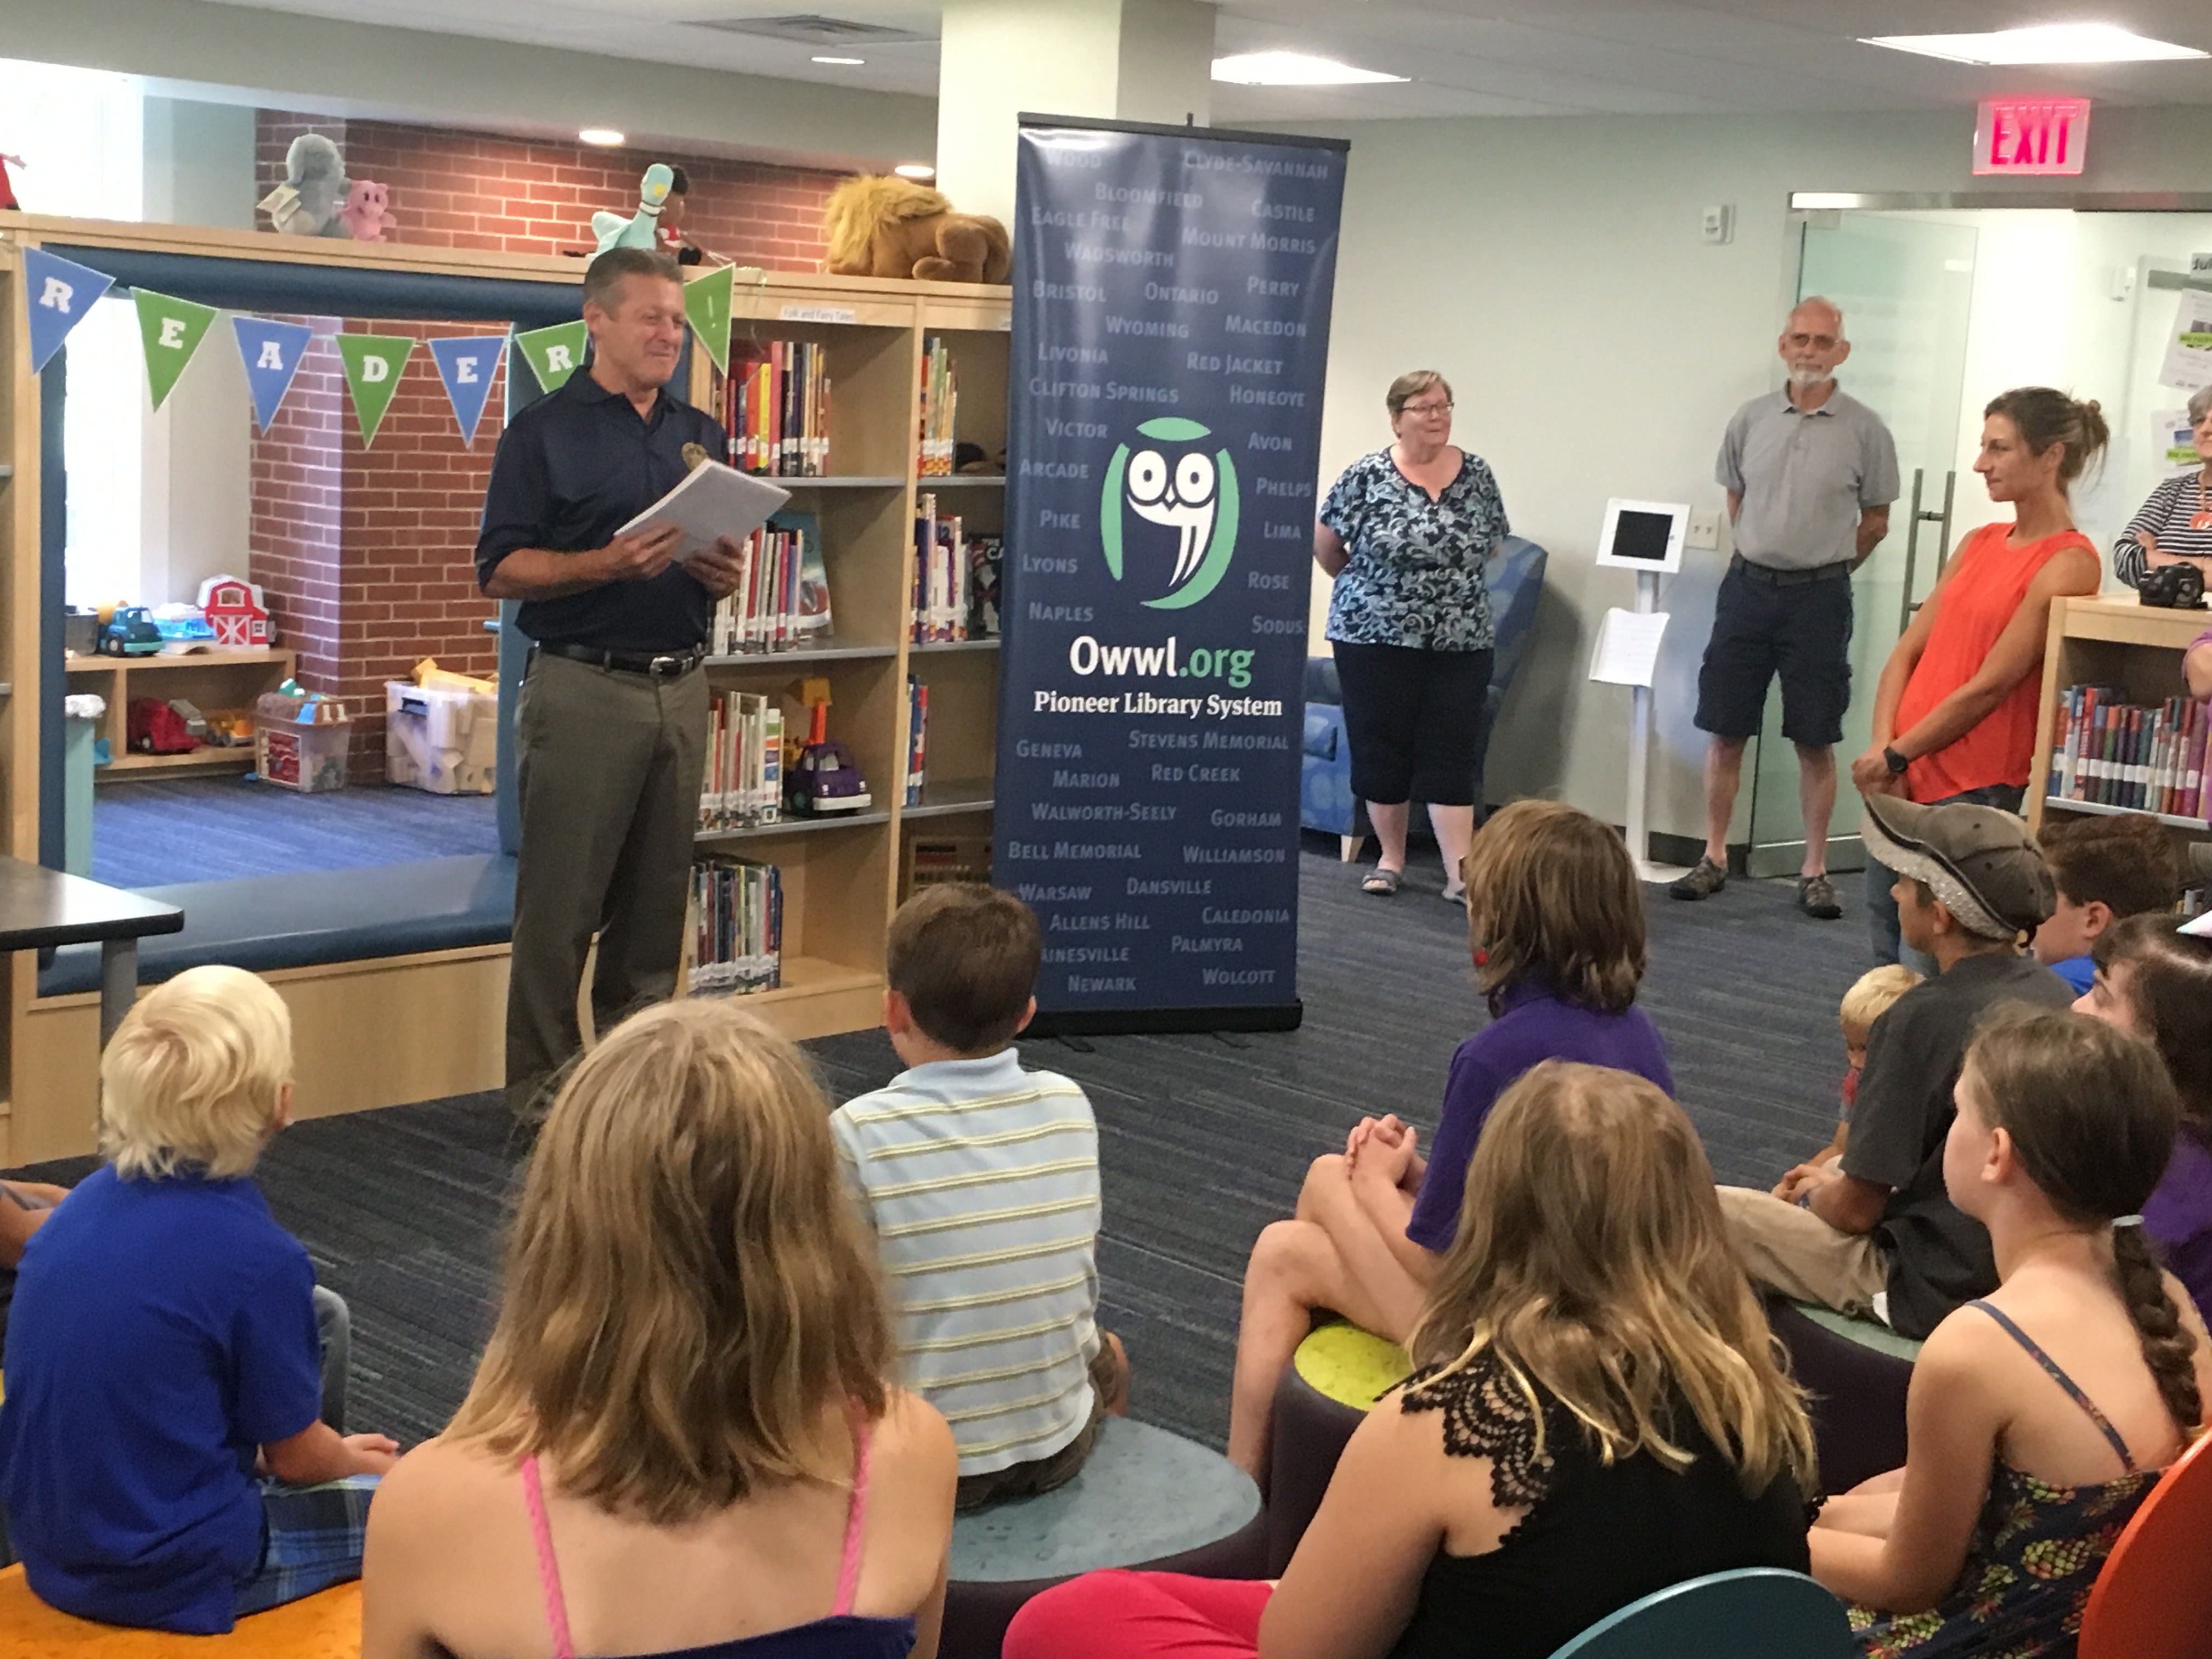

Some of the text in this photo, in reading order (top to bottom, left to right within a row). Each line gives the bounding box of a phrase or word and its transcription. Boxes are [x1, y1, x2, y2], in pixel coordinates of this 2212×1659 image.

[1990, 106, 2077, 165] EXIT
[1184, 150, 1329, 179] CLYDE-SAVANNAH
[1095, 182, 1203, 209] BLOOMFIELD
[1032, 207, 1085, 227] EAGLE
[1251, 198, 1315, 222] CASTILE
[1182, 226, 1316, 255] MOUNT MORRIS
[1064, 242, 1173, 267] WADSWORTH
[1034, 280, 1107, 302] BRISTOL
[1145, 282, 1218, 304] ONTARIO
[1247, 276, 1299, 296] PERRY
[1106, 315, 1189, 338] WYOMING
[1225, 314, 1307, 337] MACEDON
[1038, 342, 1109, 364] LIVONIA
[1187, 351, 1283, 375] RED JACKET
[1029, 377, 1178, 403] CLIFTON SPRINGS
[1230, 385, 1305, 407] HONEOYE
[1046, 418, 1108, 438] VICTOR
[1248, 432, 1292, 451] AVON
[1019, 459, 1089, 479] ARCADE
[1256, 477, 1312, 497] PHELPS
[1040, 510, 1080, 528] PIKE
[1264, 521, 1301, 539] LIMA
[1023, 554, 1078, 574] LYONS
[1248, 571, 1289, 590] ROSE
[1029, 602, 1094, 622] NAPLES
[1251, 615, 1303, 634] SODUS
[1069, 635, 1255, 688] Owwl.org
[1034, 691, 1283, 720] Pioneer Library System
[1017, 740, 1082, 758] GENEVA
[1128, 730, 1289, 749] STEVENS MEMORIAL
[1053, 770, 1120, 788] MARION
[1152, 764, 1240, 782] RED CREEK
[1031, 802, 1177, 821] WALWORTH-SEELY
[1211, 809, 1282, 827] GORHAM
[1009, 841, 1142, 860] BELL MEMORIAL
[1183, 845, 1285, 863] WILLIAMSON
[1018, 883, 1092, 900] WARSAW
[1126, 877, 1211, 894] DANSVILLE
[1049, 913, 1150, 930] ALLENS HILL
[1202, 907, 1289, 924] CALEDONIA
[1172, 935, 1243, 953] PALMYRA
[1068, 975, 1136, 992] NEWARK
[1203, 968, 1276, 986] WOLCOTT
